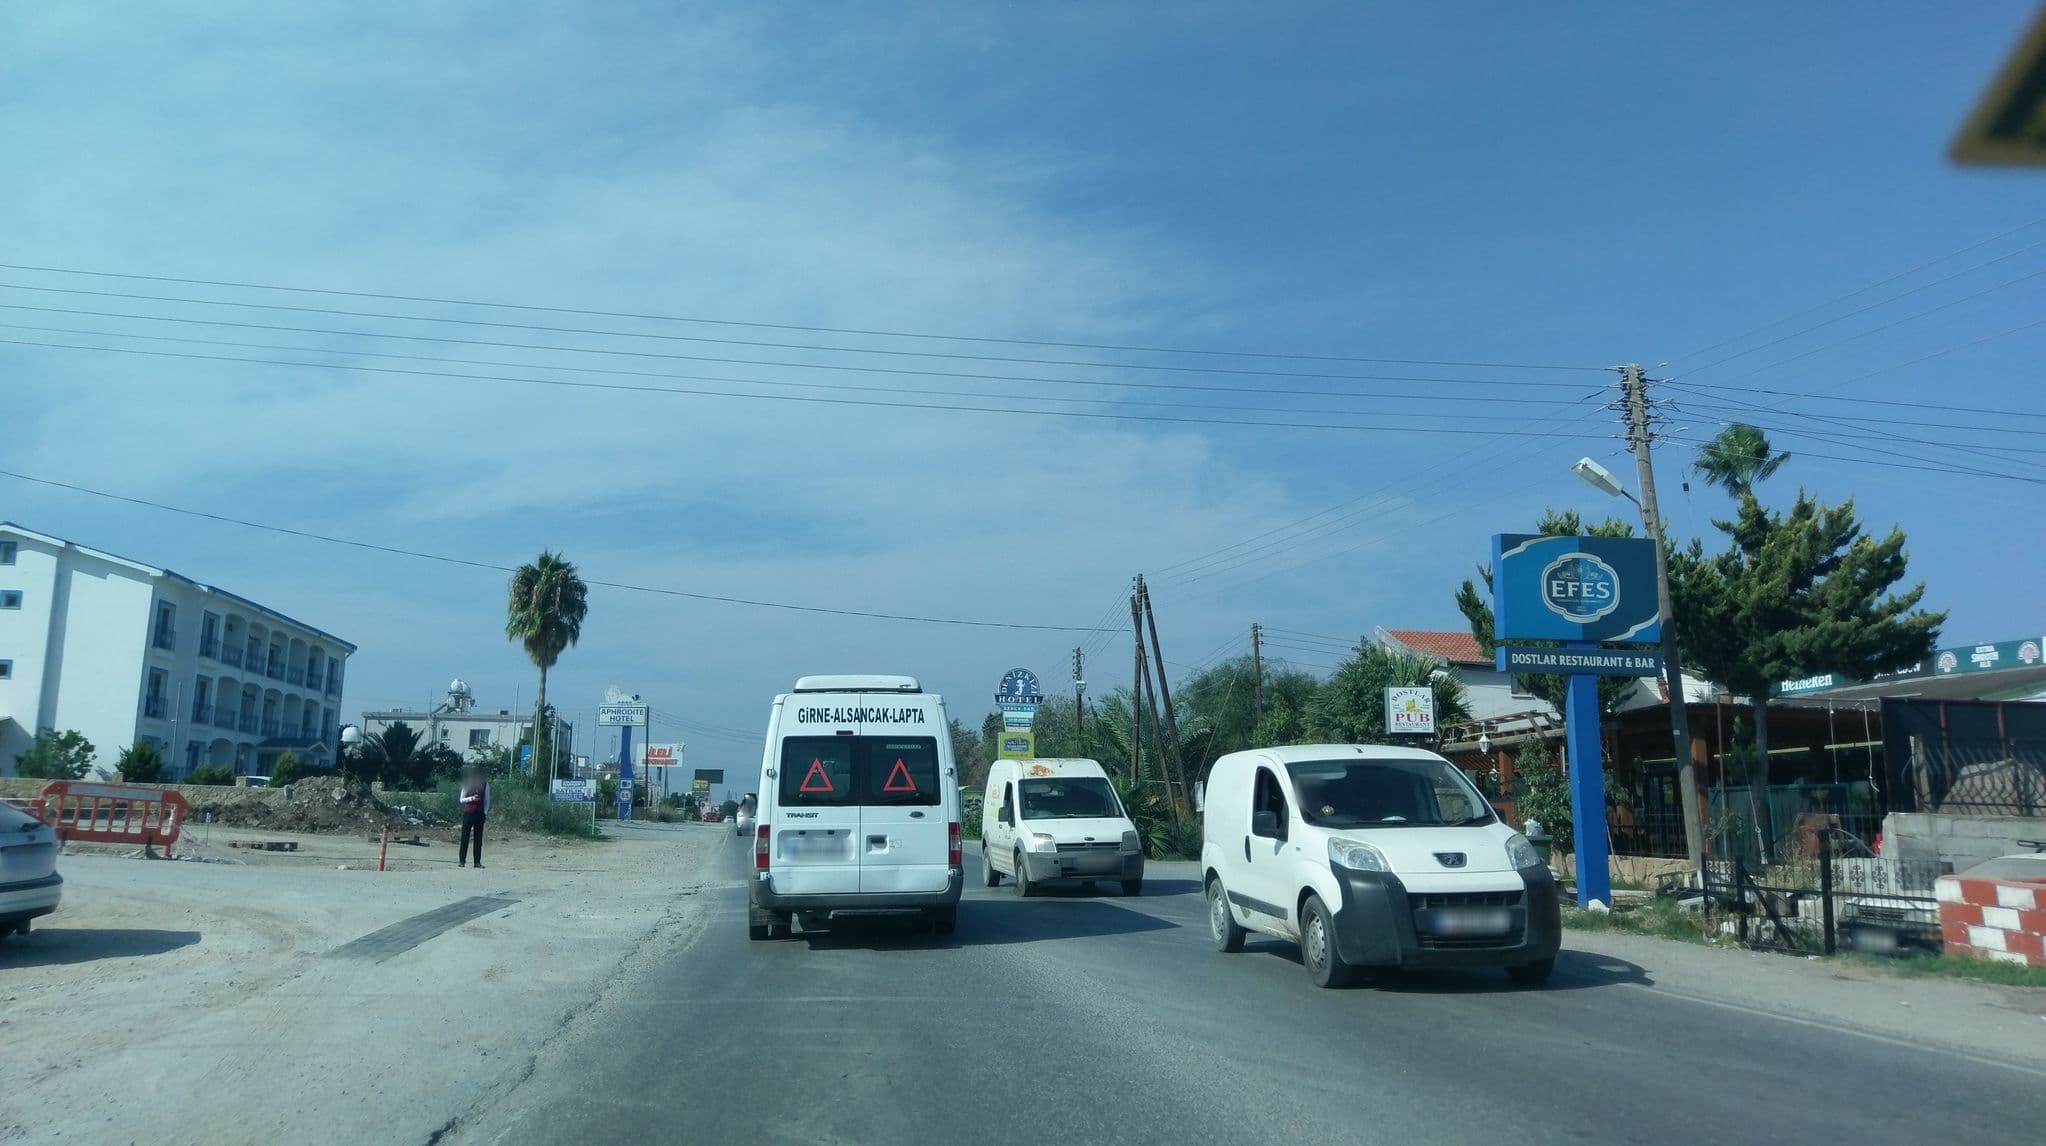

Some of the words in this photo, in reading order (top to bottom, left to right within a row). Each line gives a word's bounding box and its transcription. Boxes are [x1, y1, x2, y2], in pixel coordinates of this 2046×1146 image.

[1551, 580, 1610, 599] EFES
[1511, 653, 1557, 666] DOSTLAR
[1559, 655, 1623, 668] RESTAURANT
[1625, 658, 1633, 668] &
[1635, 658, 1655, 669] BAR
[999, 695, 1040, 703] HOTEL
[600, 708, 645, 716] APHRODITE
[1395, 713, 1430, 722] PUB
